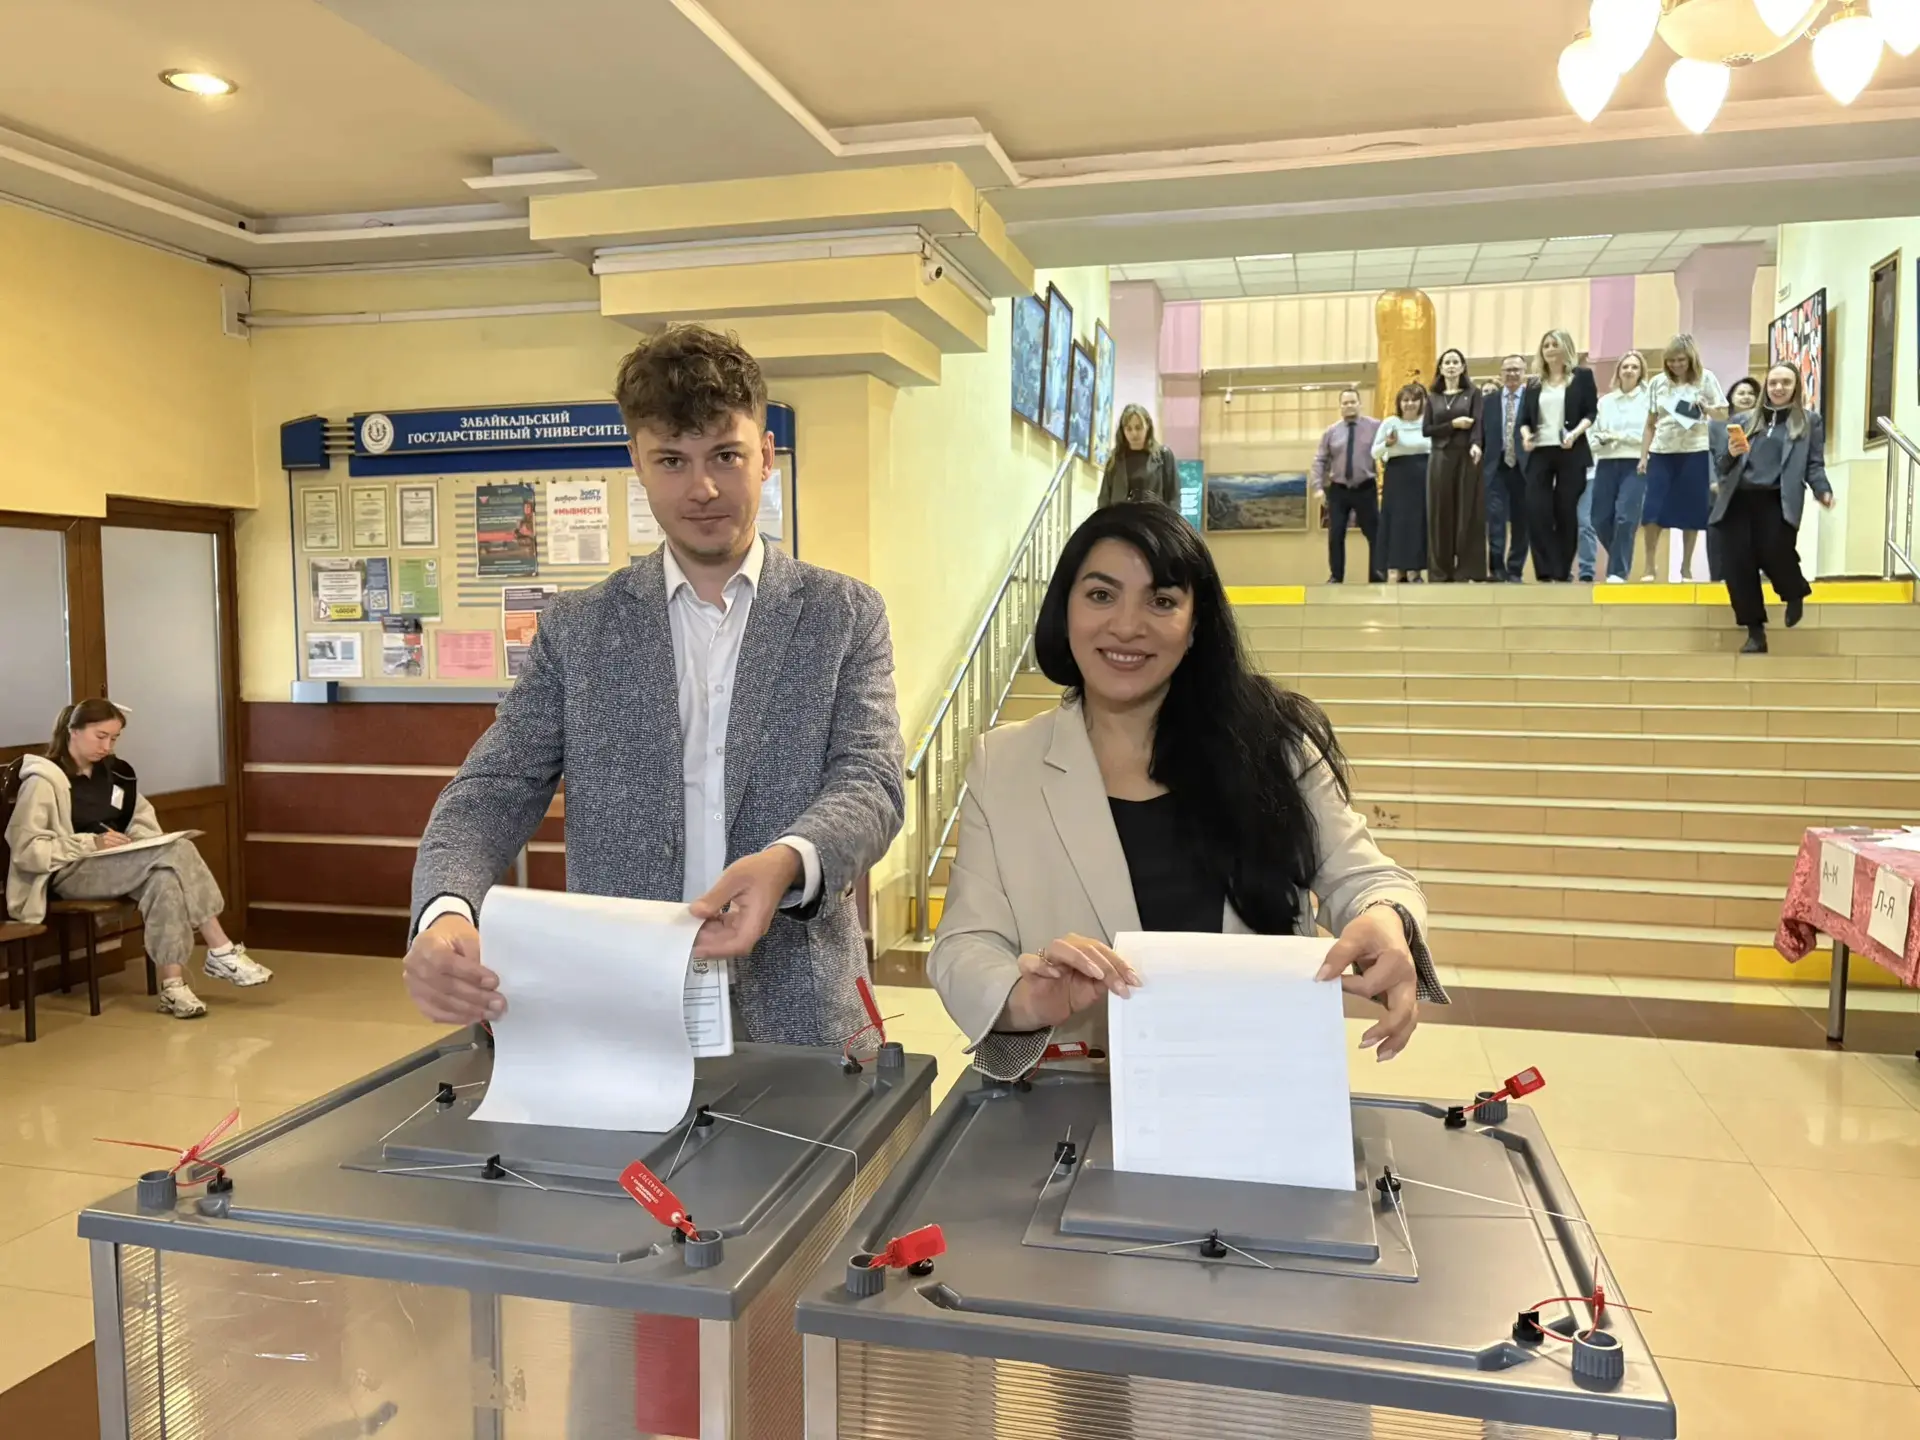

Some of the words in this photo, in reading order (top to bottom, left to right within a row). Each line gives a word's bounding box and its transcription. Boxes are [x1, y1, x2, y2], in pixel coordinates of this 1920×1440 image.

[460, 411, 570, 428] ЗАБАЙКАЛЬСКИЙ
[408, 427, 531, 444] ГОСУДАРСТВЕННЫЙ
[1822, 861, 1839, 886] А-К
[1874, 890, 1896, 919] Л-Я
